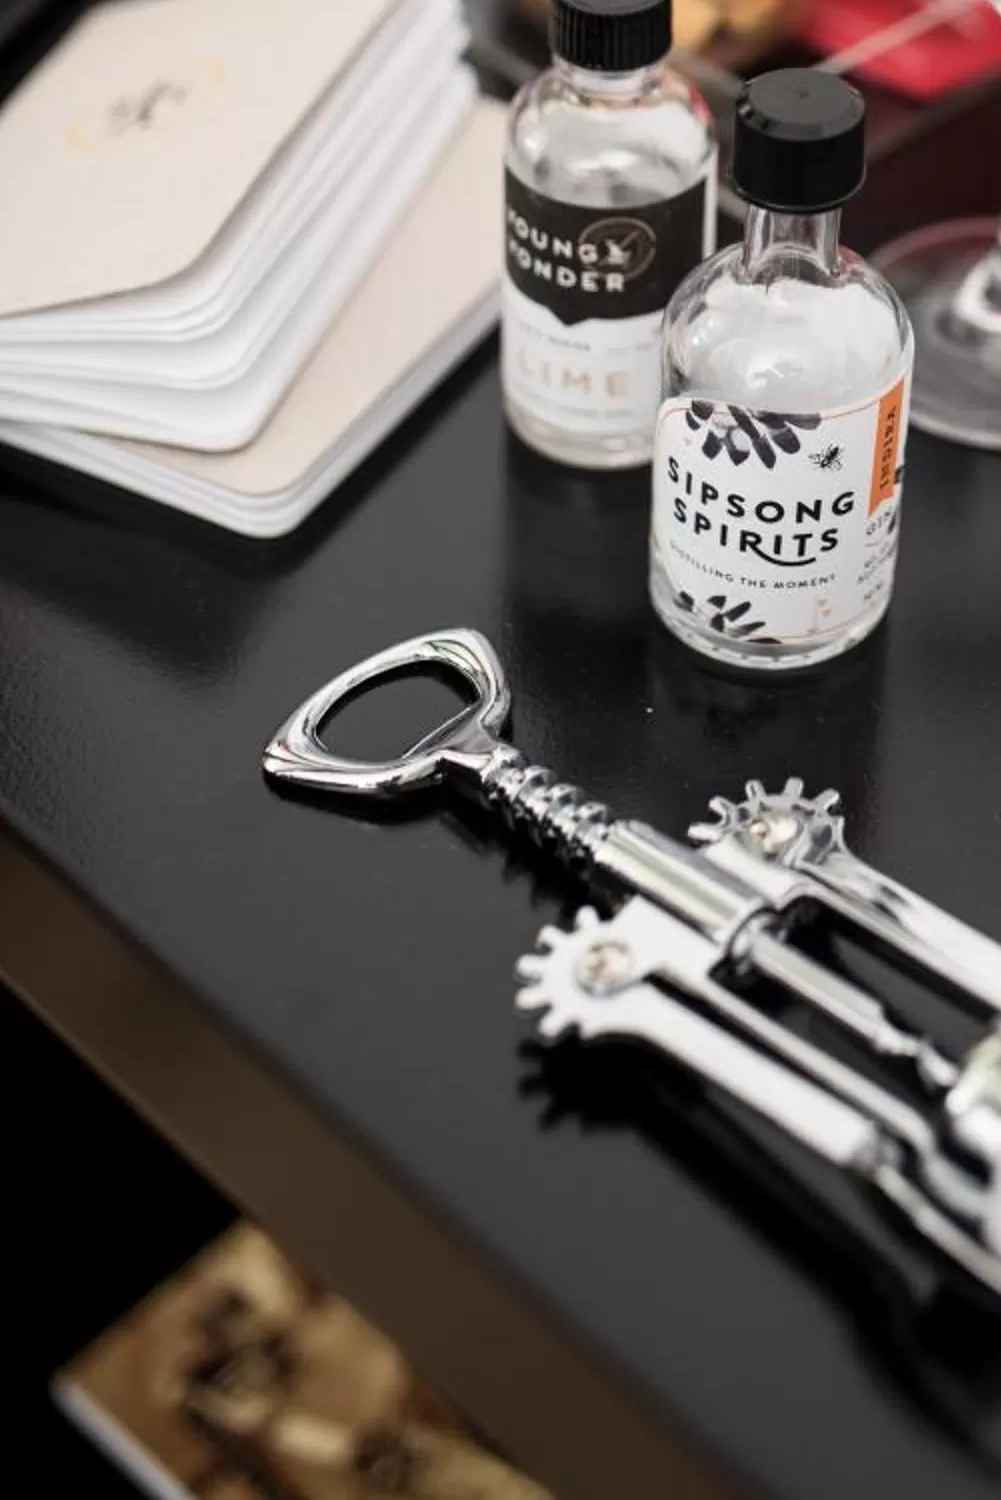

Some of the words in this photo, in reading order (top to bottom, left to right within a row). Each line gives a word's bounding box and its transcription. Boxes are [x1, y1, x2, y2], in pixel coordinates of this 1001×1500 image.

[516, 346, 628, 399] LIME
[668, 456, 855, 524] SIPSONG
[673, 497, 839, 567] SPIRITS
[740, 576, 767, 589] THE
[773, 572, 836, 590] MOMENT
